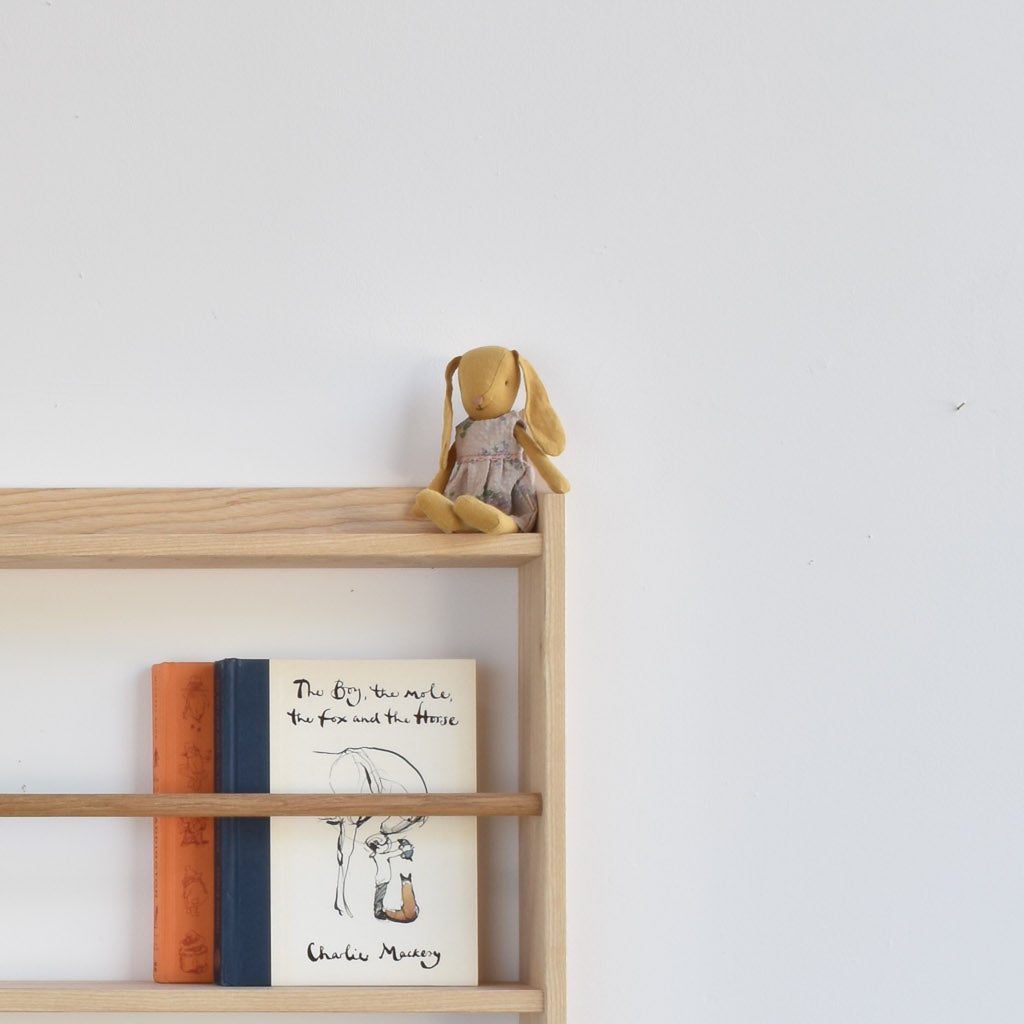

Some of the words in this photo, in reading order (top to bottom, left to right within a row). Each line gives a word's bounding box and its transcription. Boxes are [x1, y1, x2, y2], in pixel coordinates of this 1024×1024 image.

[293, 678, 324, 699] The
[331, 679, 367, 707] Boy,
[369, 684, 400, 699] the
[287, 708, 315, 725] the
[318, 708, 348, 728] fox
[352, 712, 381, 725] and
[384, 708, 411, 725] the
[413, 701, 459, 726] Horse
[307, 942, 369, 962] Charlie
[379, 942, 441, 970] Mackesy
